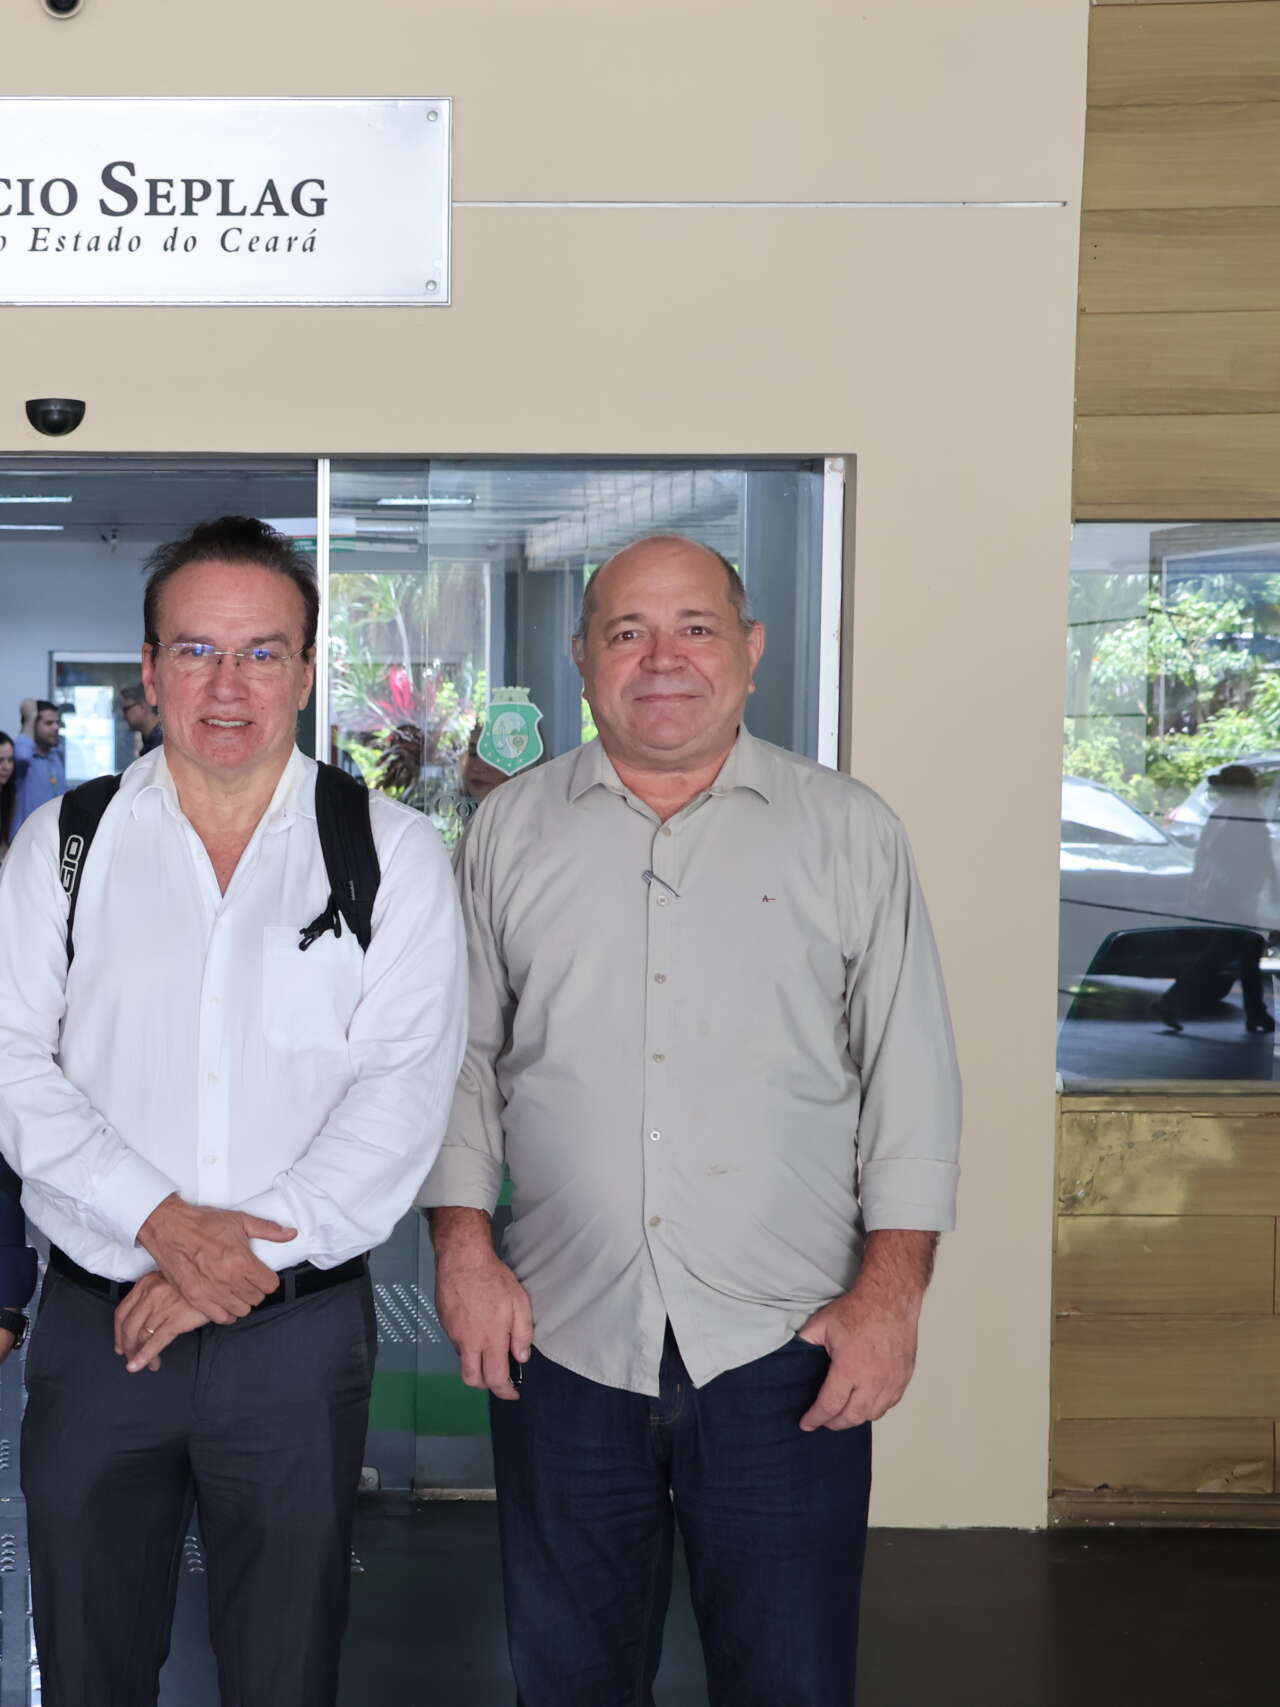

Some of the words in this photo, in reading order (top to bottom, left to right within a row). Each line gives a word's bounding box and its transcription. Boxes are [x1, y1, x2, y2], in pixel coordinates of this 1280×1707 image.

[98, 161, 328, 217] SEPLAG
[28, 226, 141, 252] Estado
[163, 226, 197, 252] do
[220, 227, 317, 252] Ceará
[61, 834, 84, 920] GIO
